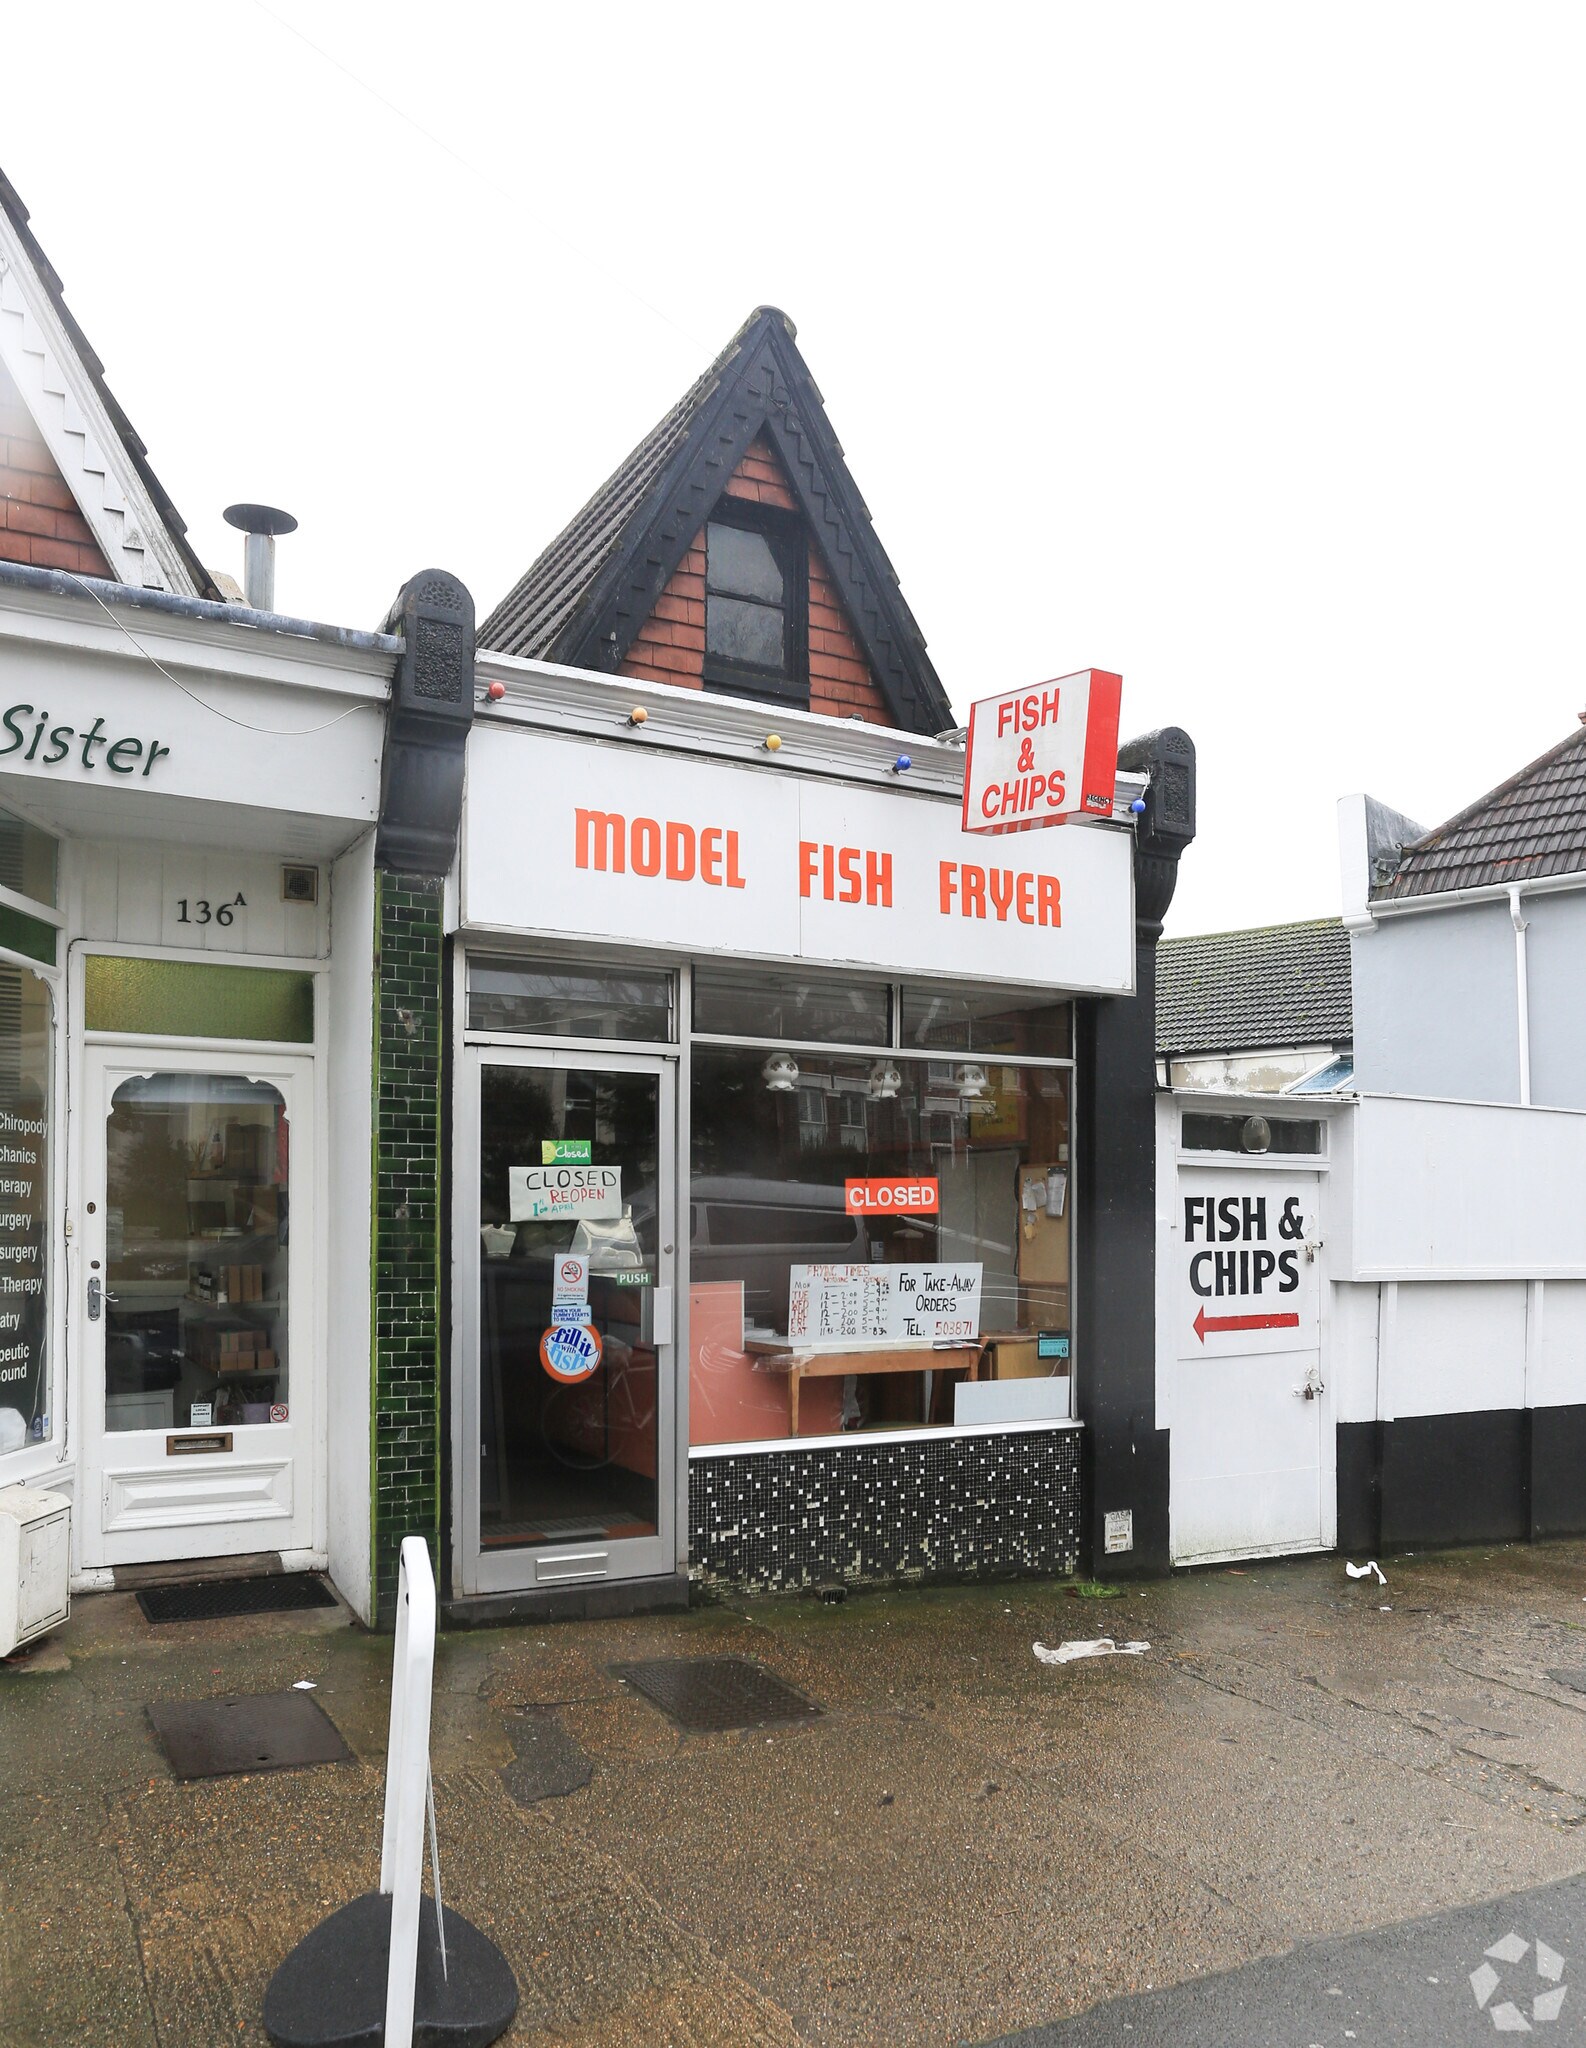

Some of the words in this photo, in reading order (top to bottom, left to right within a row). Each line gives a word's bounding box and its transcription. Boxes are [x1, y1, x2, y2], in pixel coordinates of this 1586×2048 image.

[998, 687, 1060, 738] FISH
[0, 704, 170, 776] Sister
[1017, 737, 1035, 773] &
[981, 770, 1066, 818] CHIPS
[575, 808, 746, 888] MODEL
[800, 841, 893, 908] FISH
[940, 861, 1062, 928] FRYER
[555, 1145, 590, 1158] Closed
[526, 1169, 617, 1191] CLOSED
[549, 1188, 605, 1204] REOPEN
[849, 1186, 936, 1207] CLOSED
[1184, 1197, 1267, 1242] FISH
[1278, 1197, 1304, 1240] &
[619, 1274, 649, 1284] PUSH
[1189, 1250, 1299, 1296] CHIPS
[2, 1277, 43, 1295] Therapy
[915, 1294, 957, 1313] ORDERS
[551, 1327, 582, 1347] fill
[935, 1321, 973, 1336] 503871
[548, 1343, 587, 1371] fish
[561, 1344, 577, 1355] with
